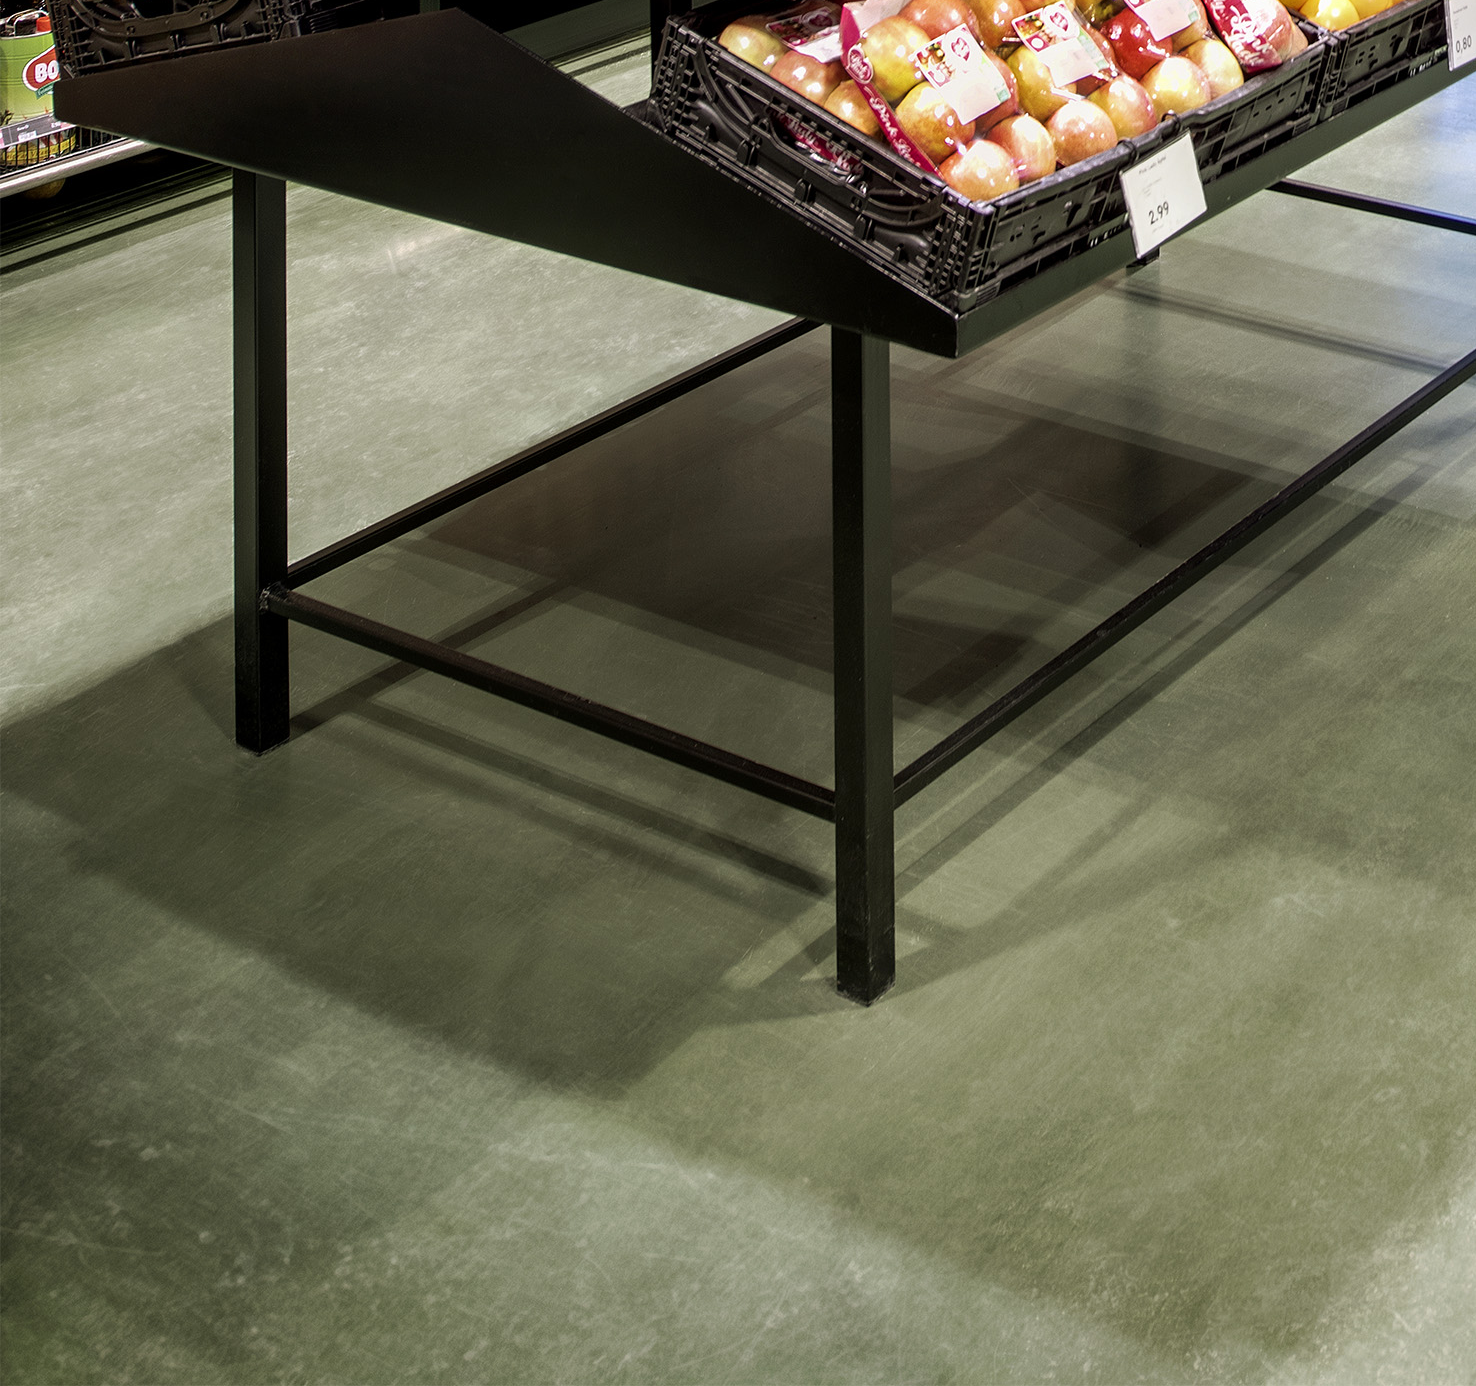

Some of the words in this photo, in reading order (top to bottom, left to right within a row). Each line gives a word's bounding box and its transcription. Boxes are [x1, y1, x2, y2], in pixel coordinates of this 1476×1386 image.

[1455, 35, 1473, 54] 0,80
[34, 60, 59, 84] BO
[864, 86, 898, 139] Pink
